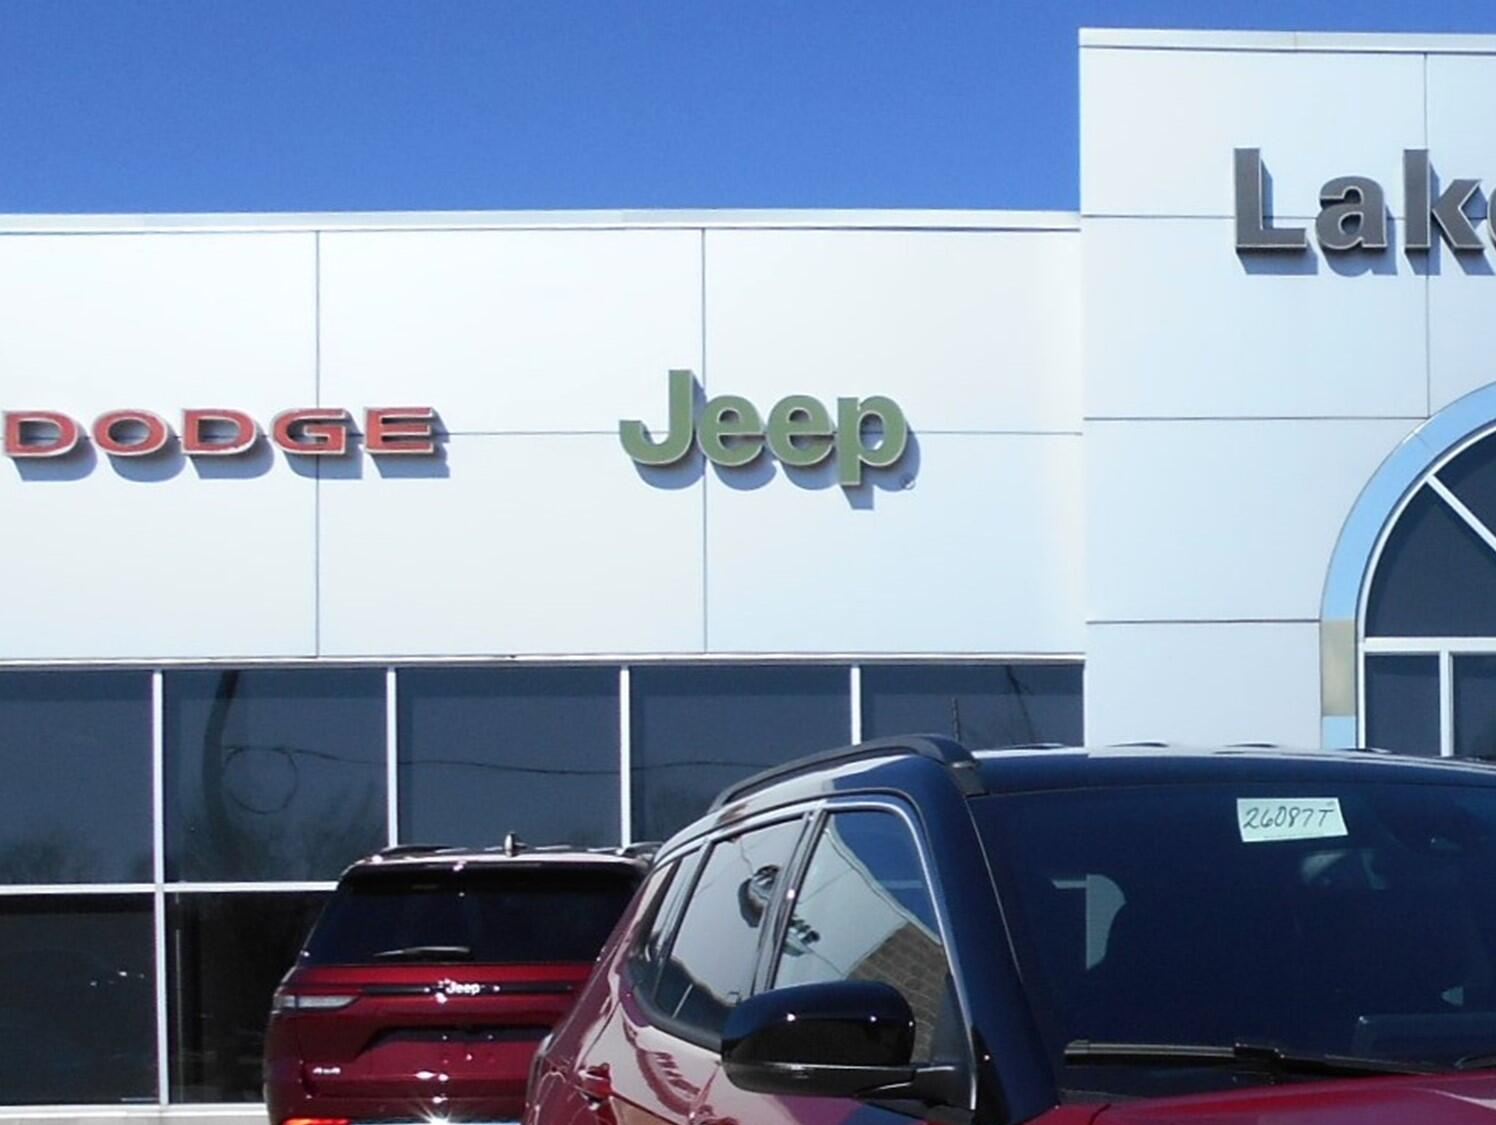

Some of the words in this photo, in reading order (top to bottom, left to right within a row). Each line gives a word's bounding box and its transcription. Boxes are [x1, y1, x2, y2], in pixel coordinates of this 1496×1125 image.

[2, 406, 436, 458] DODGE
[618, 369, 908, 487] Jeep
[445, 980, 481, 996] Jeep
